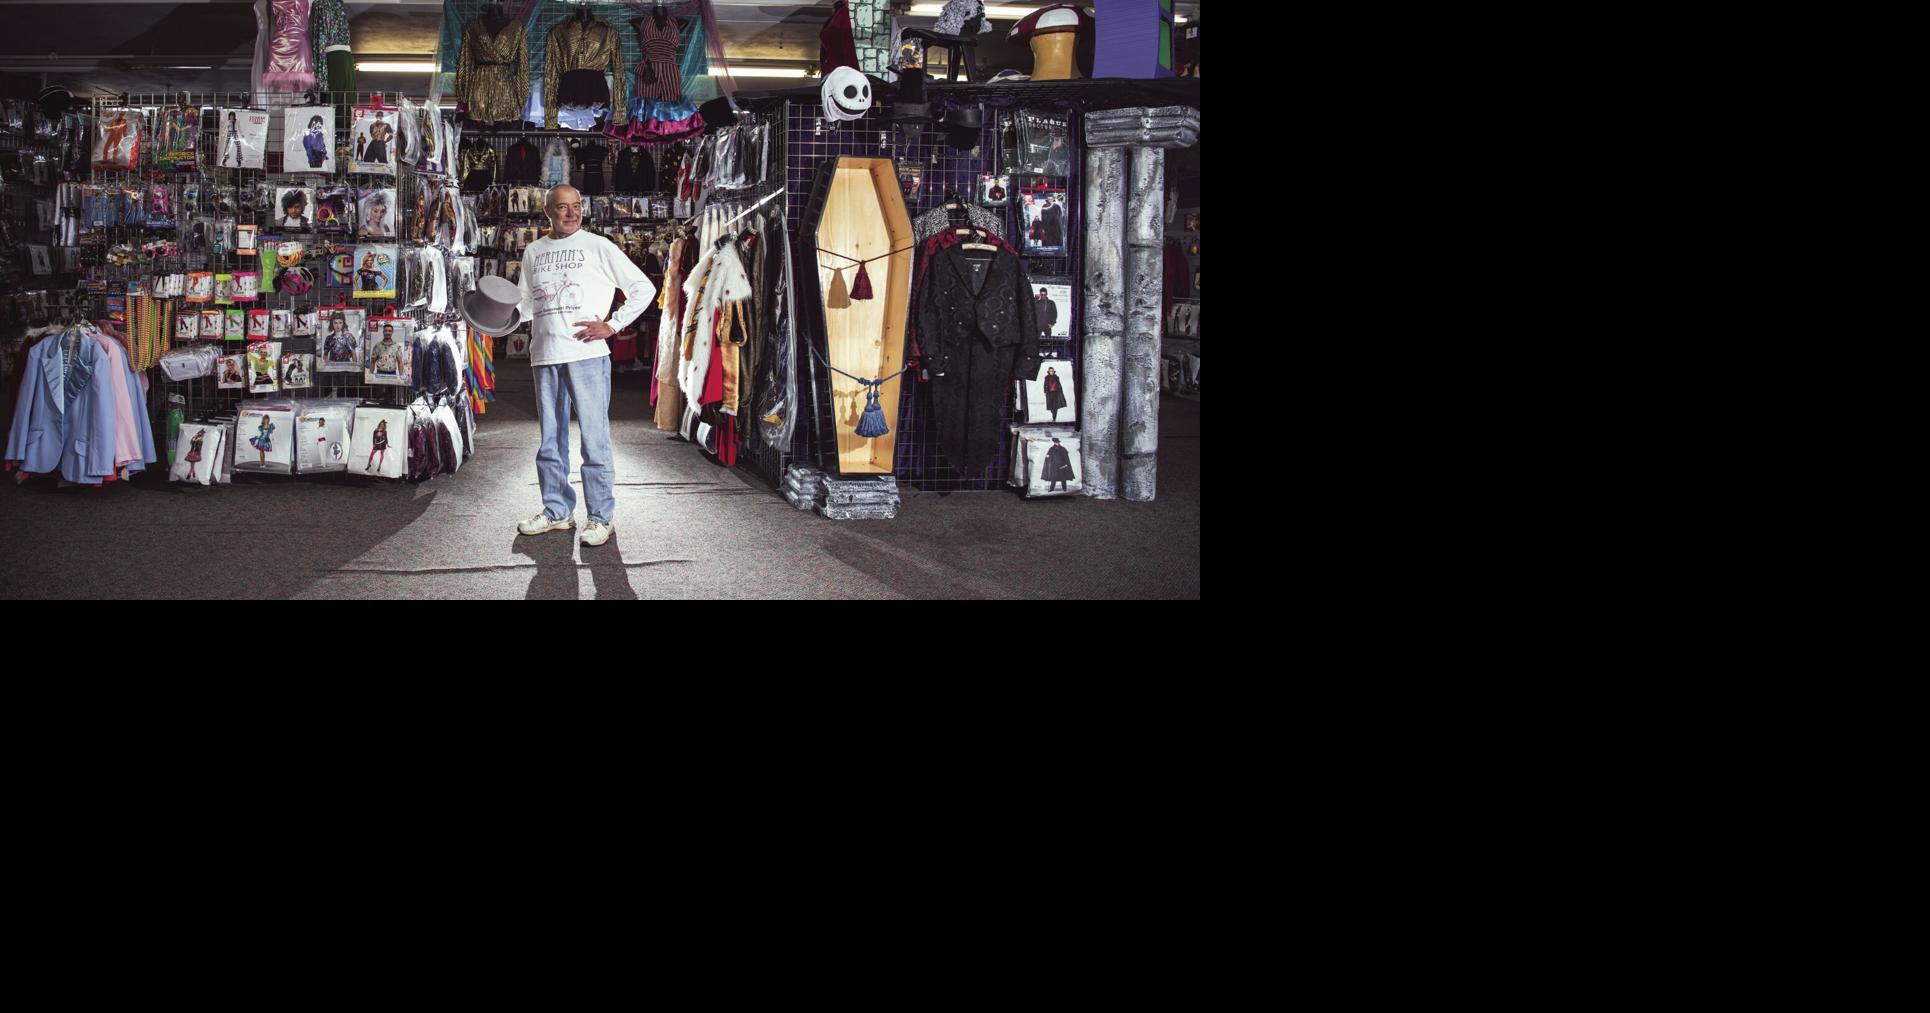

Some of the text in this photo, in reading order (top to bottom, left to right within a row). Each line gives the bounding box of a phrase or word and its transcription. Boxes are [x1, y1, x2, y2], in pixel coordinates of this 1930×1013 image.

[1027, 116, 1068, 128] PLAGUE
[533, 249, 585, 268] HERMAN'S
[533, 262, 583, 273] BIKE SHOP
